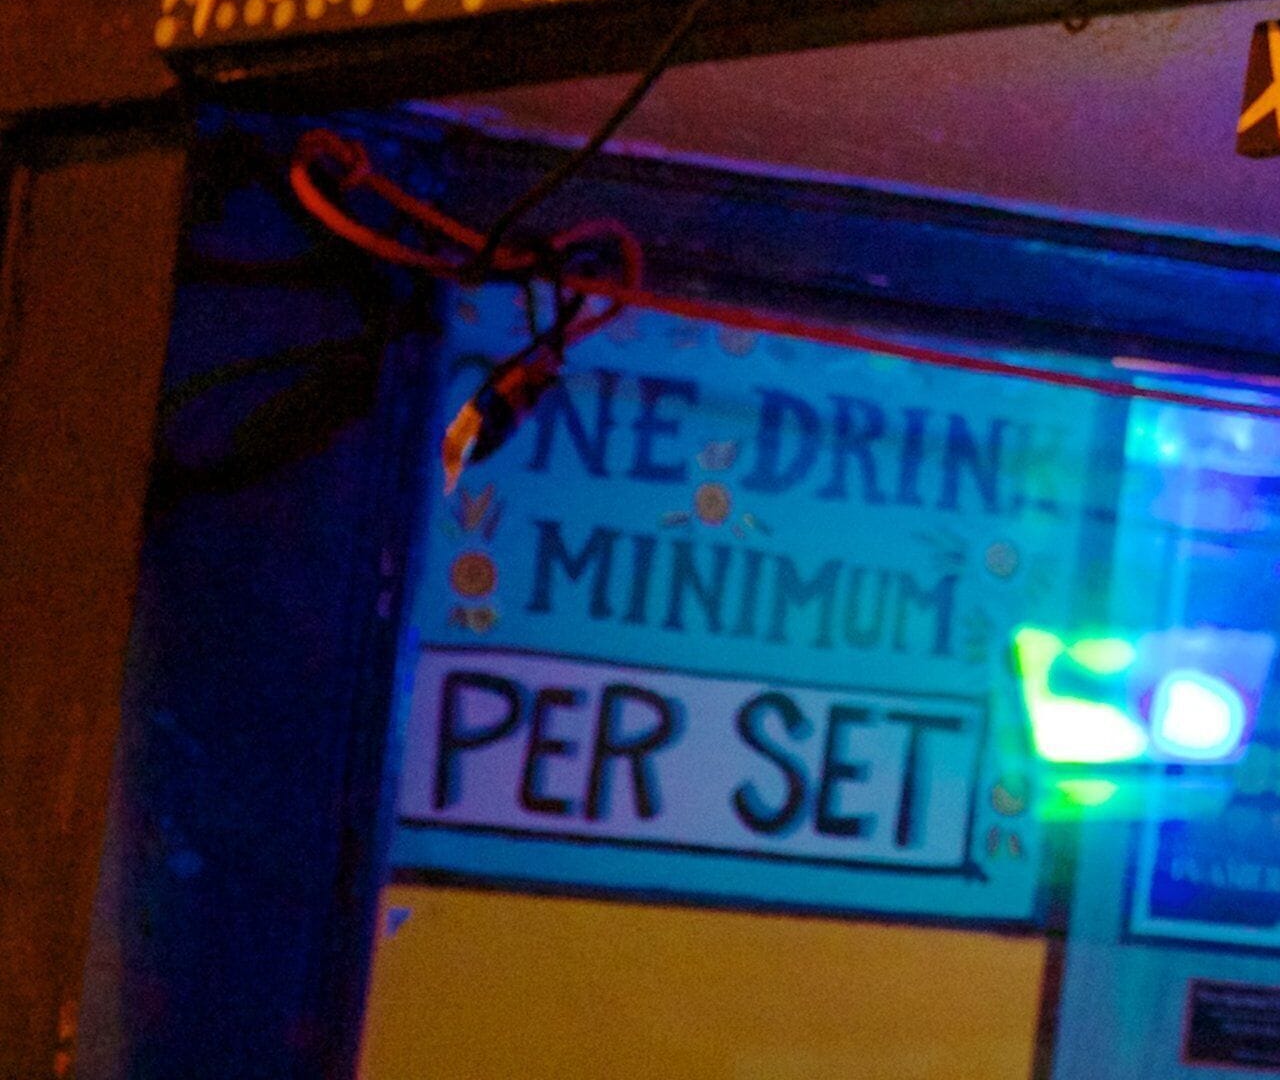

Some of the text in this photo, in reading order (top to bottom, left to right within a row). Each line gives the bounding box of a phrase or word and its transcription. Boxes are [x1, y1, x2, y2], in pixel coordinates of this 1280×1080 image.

[447, 353, 698, 485] NE
[527, 520, 961, 659] MINIMUM
[431, 671, 964, 847] PER SET
